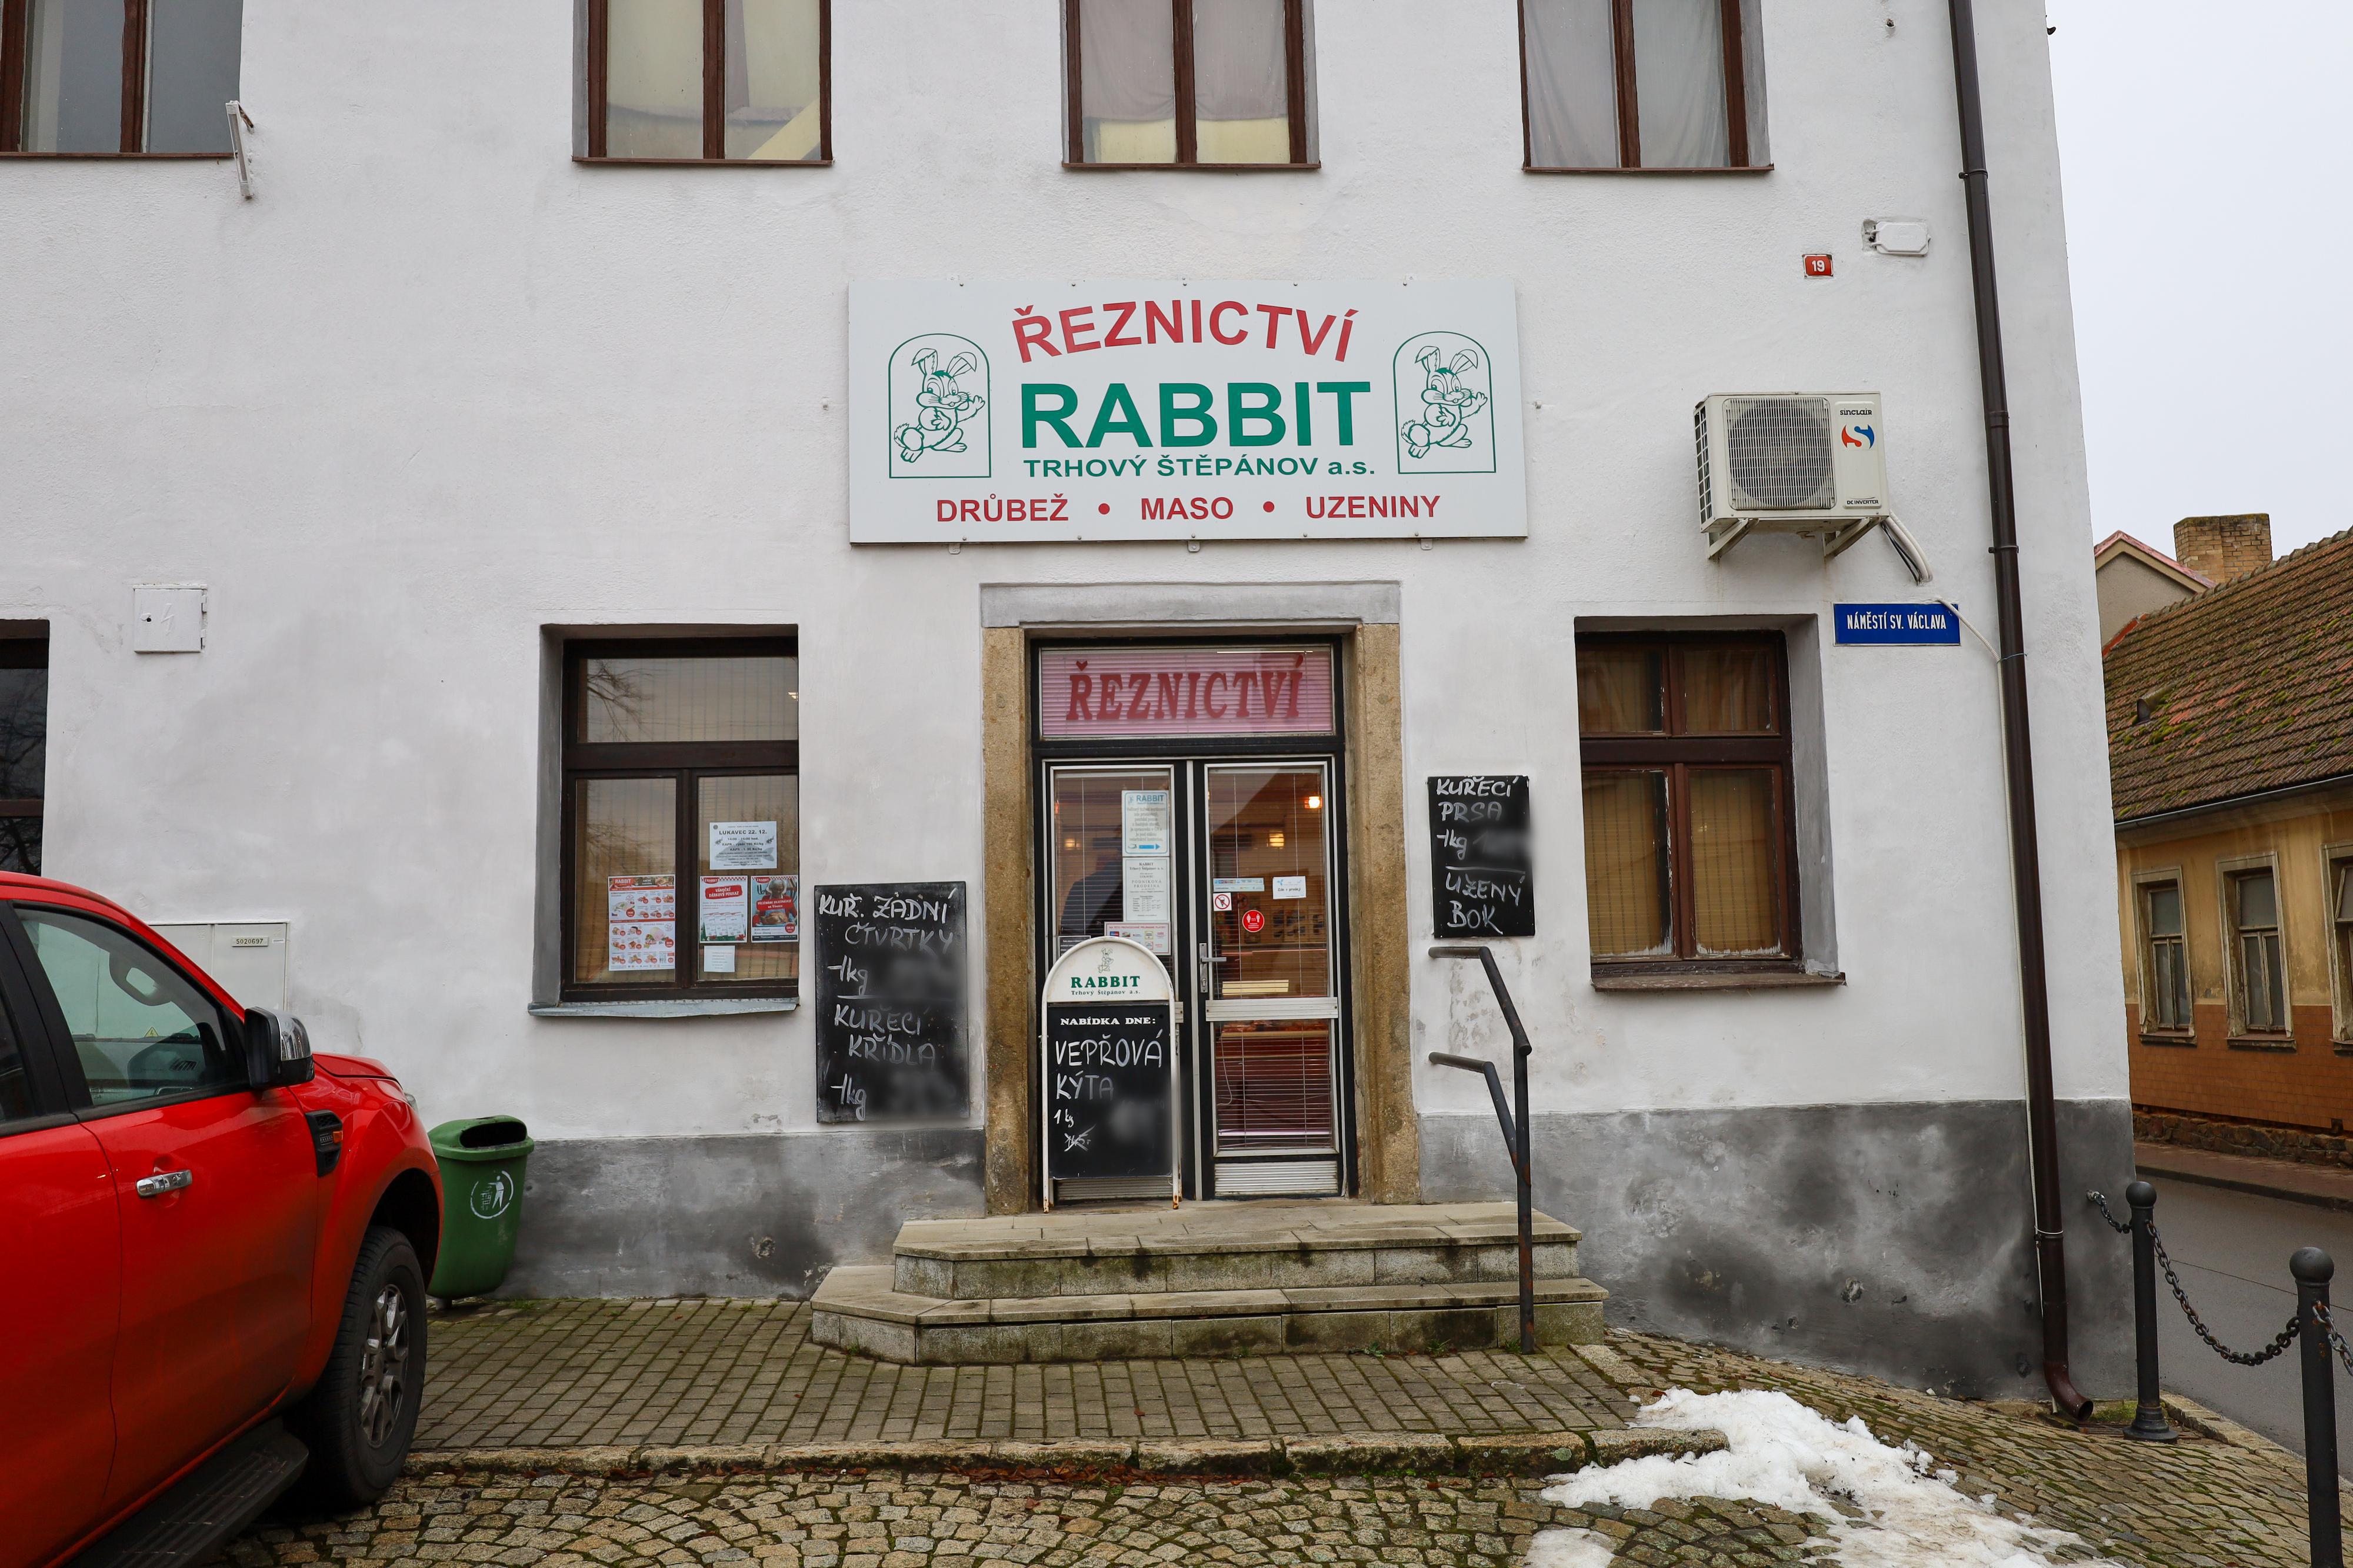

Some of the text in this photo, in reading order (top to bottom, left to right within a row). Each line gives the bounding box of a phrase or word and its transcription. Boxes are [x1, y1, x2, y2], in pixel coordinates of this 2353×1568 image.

[1811, 260, 1825, 272] 19
[1012, 299, 1358, 363] ŘEZNICTVÍ
[1021, 381, 1371, 449] RABBIT
[1023, 453, 1375, 478] TRHOVÝ ŠTĚPÁNOV a.s.
[936, 493, 1441, 523] DRŮBEŽ MASO UZENINY
[1847, 611, 1947, 629] NÁMĚSTÍ SV. VÁCLAVA
[1066, 655, 1304, 720] ŘEZNICTVÍ
[1436, 776, 1519, 797] KUŘECÍ
[1438, 801, 1502, 823] PRSA
[1447, 900, 1503, 935] BOK
[845, 921, 954, 956] ČTVRTKY
[1071, 976, 1140, 988] RABBIT
[1060, 1016, 1156, 1026] NABÍDKA DNE:
[848, 1033, 936, 1072] KŘÍDLA
[1055, 1028, 1163, 1068] VEPŘOVÁ
[1055, 1070, 1115, 1102] KÝTA
